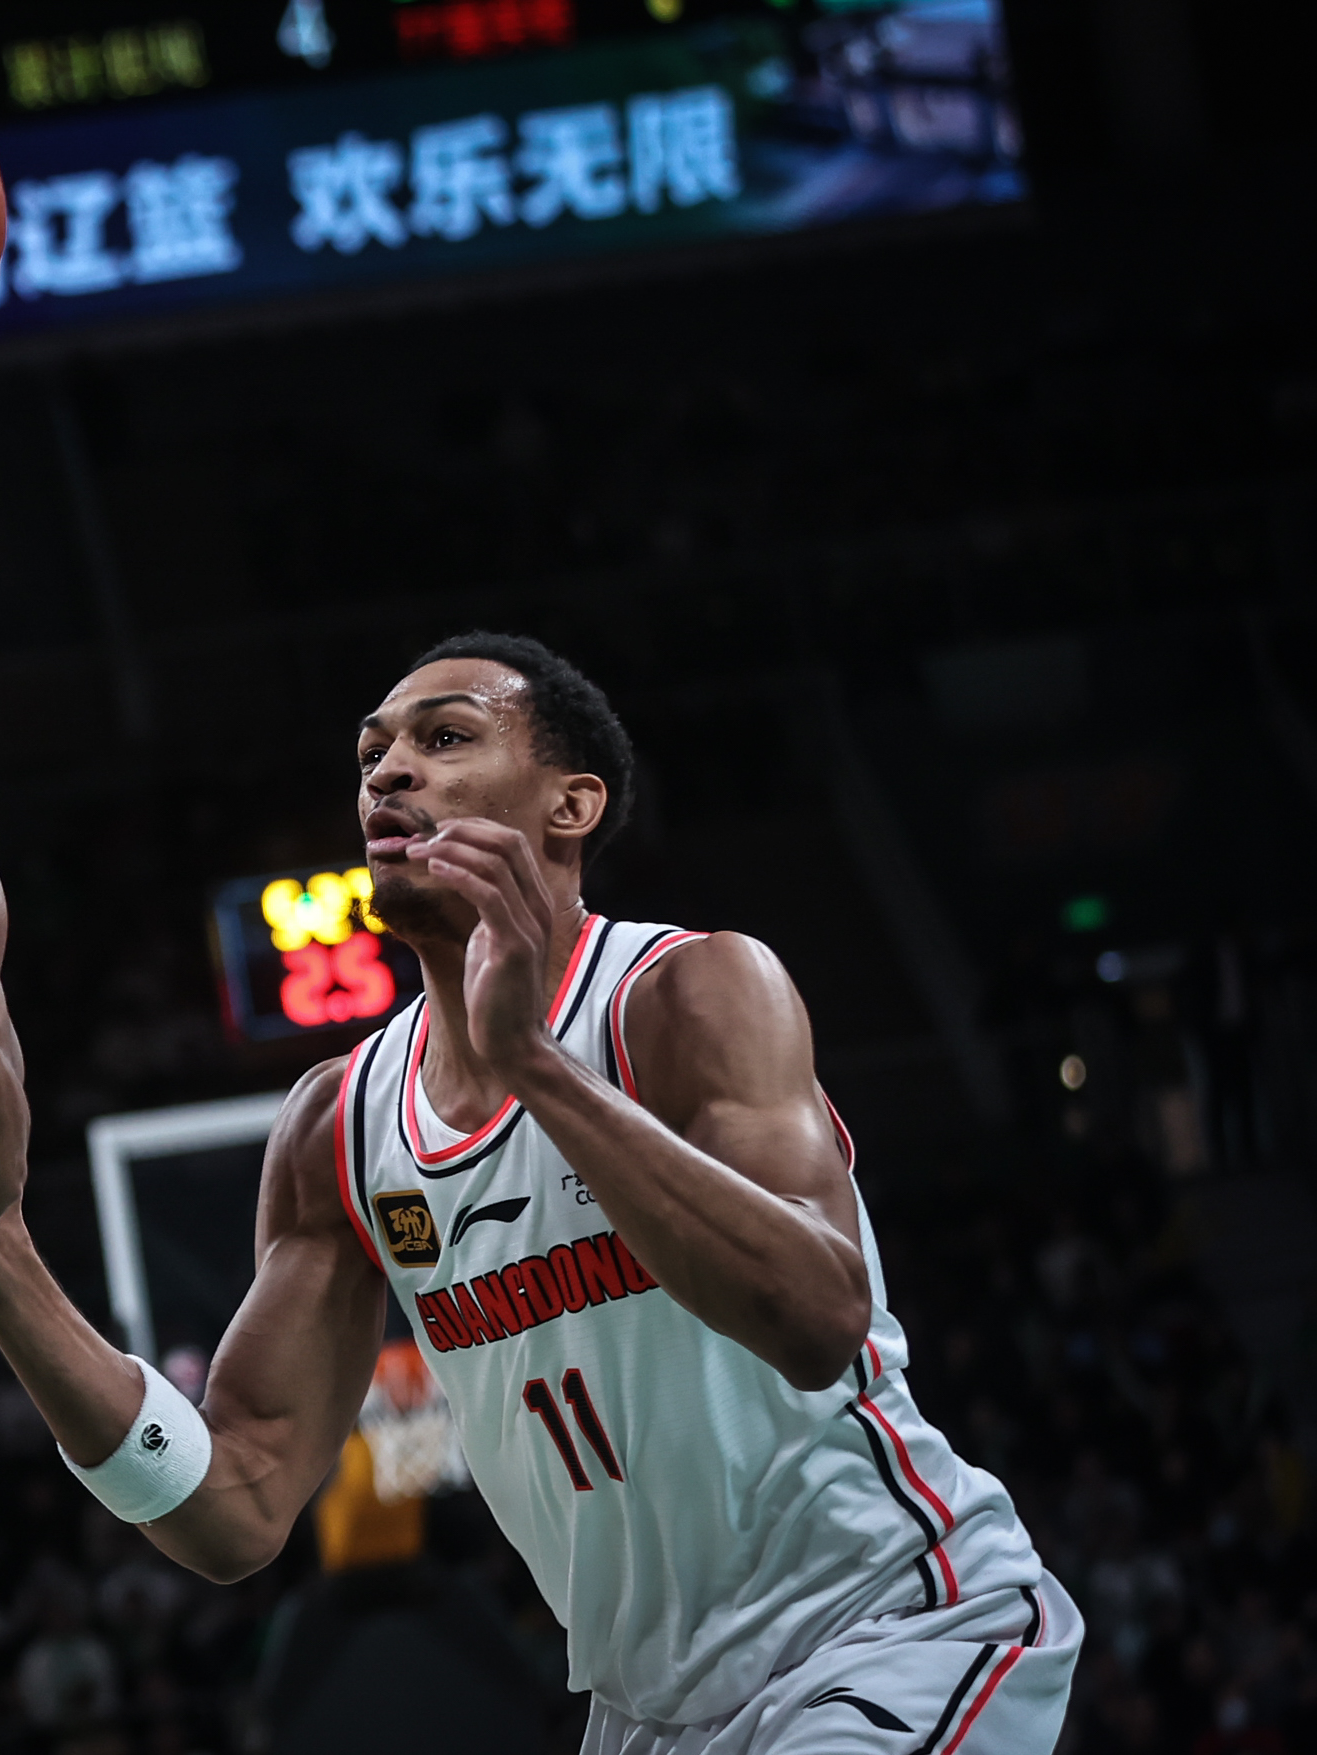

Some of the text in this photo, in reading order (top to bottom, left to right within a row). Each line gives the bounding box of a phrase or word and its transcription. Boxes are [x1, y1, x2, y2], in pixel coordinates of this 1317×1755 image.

[285, 83, 743, 255] 欢乐无限
[404, 1239, 434, 1252] CBA
[522, 1368, 625, 1491] 11
